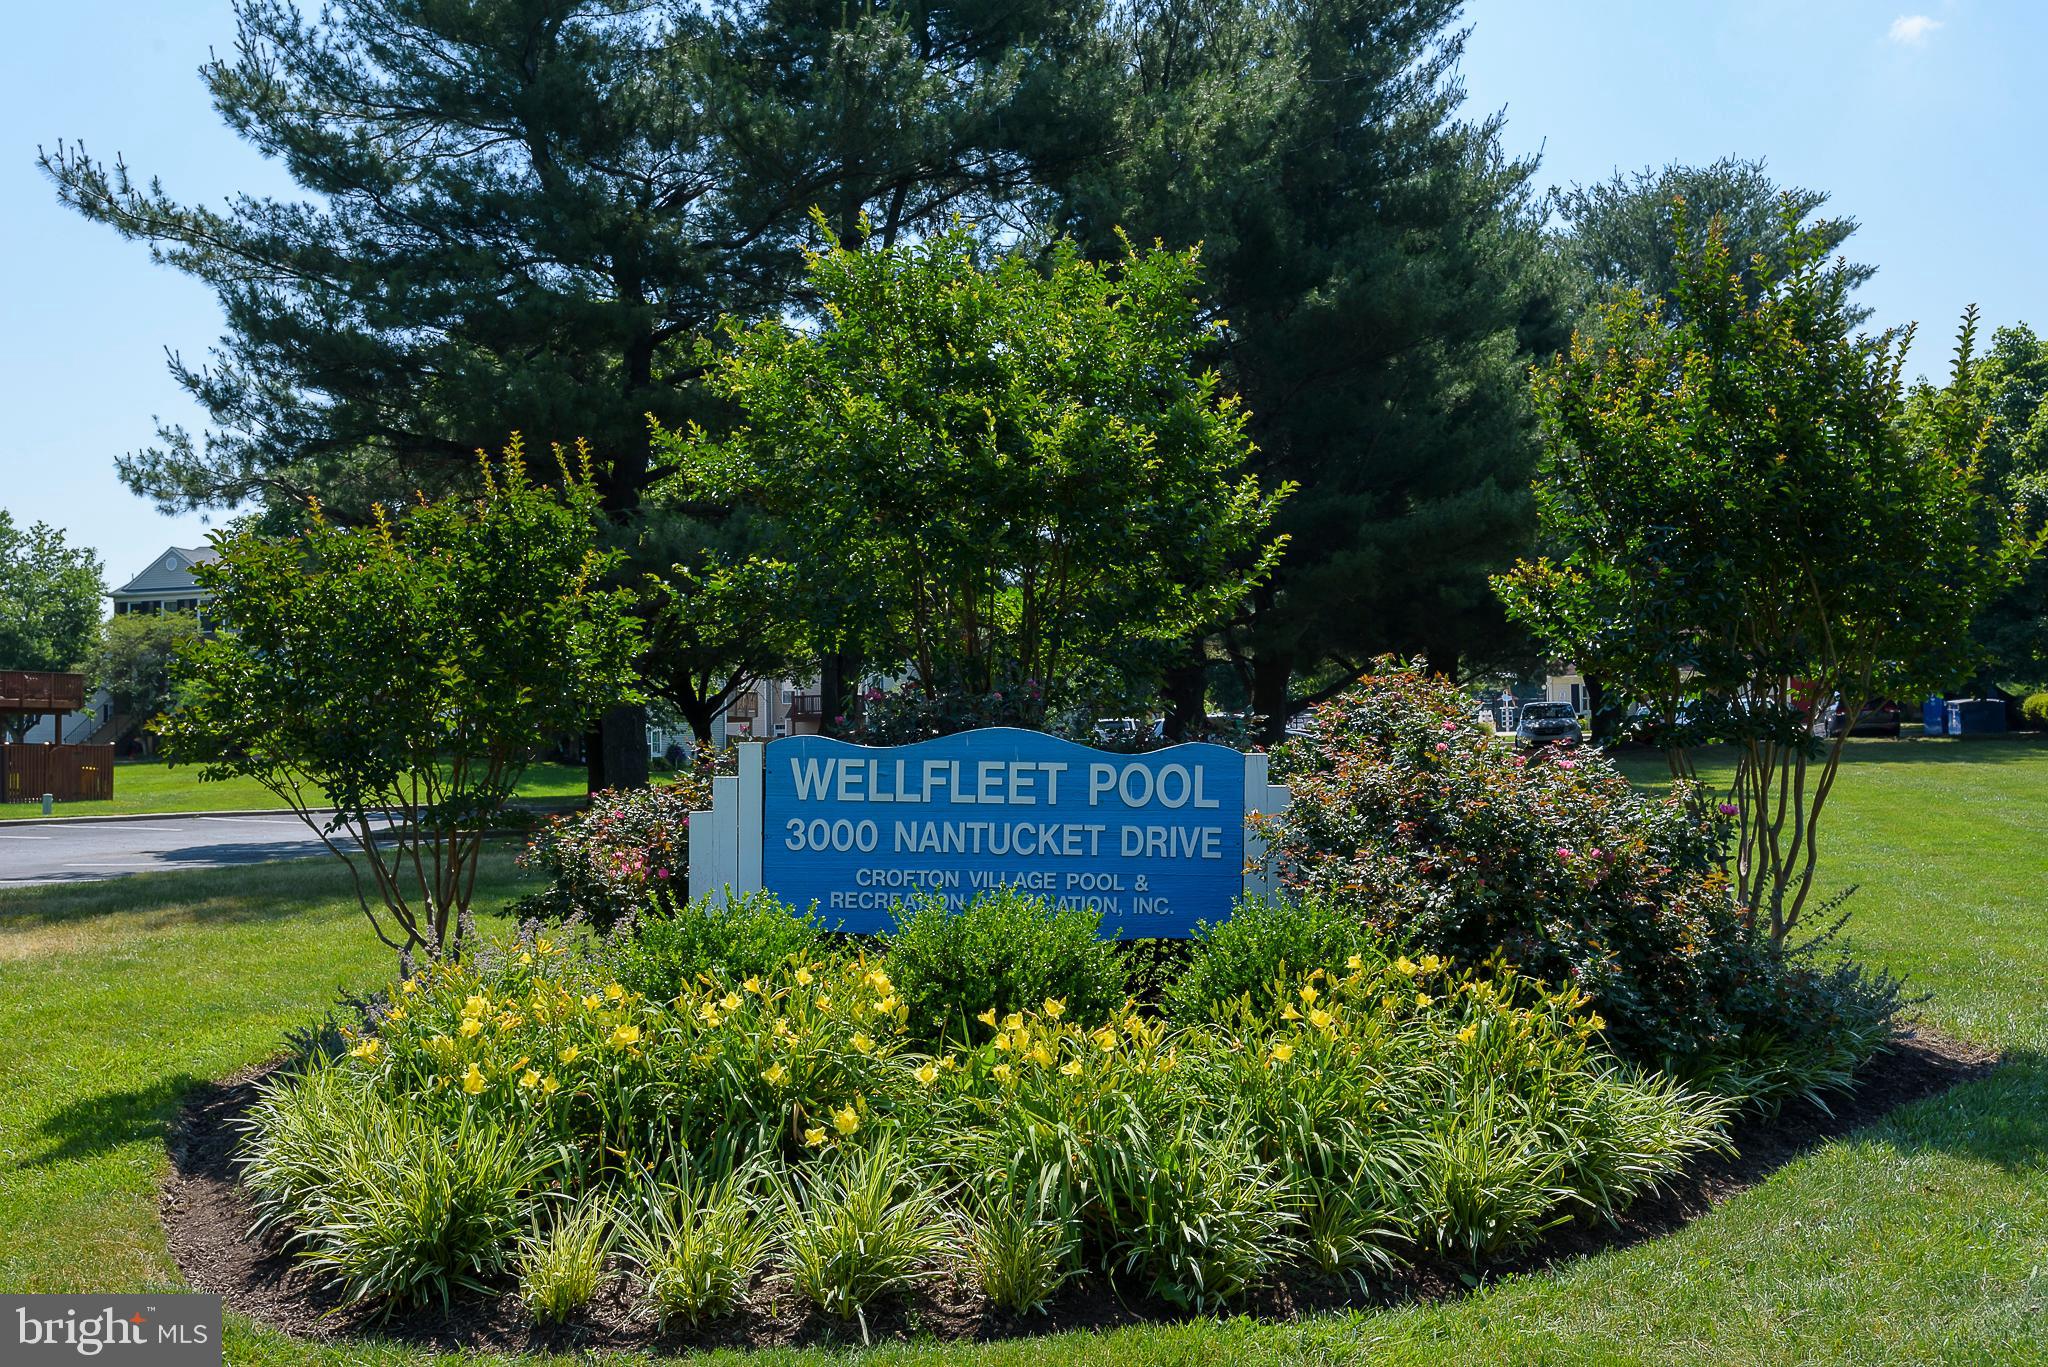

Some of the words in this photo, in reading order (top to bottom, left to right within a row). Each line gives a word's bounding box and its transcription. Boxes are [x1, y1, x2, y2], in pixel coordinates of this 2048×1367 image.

[790, 757, 1068, 806] WELLFLEET
[1089, 762, 1220, 809] POOL
[785, 818, 878, 852] 3000
[894, 821, 1106, 857] NANTUCKET
[1121, 825, 1222, 859] DRIVE
[855, 868, 959, 888] CROFTON
[968, 871, 1057, 889] VILLAGE
[1066, 873, 1125, 891] POOL
[1134, 874, 1149, 892] &
[830, 891, 964, 911] RECREAON
[1133, 897, 1174, 915] INC.
